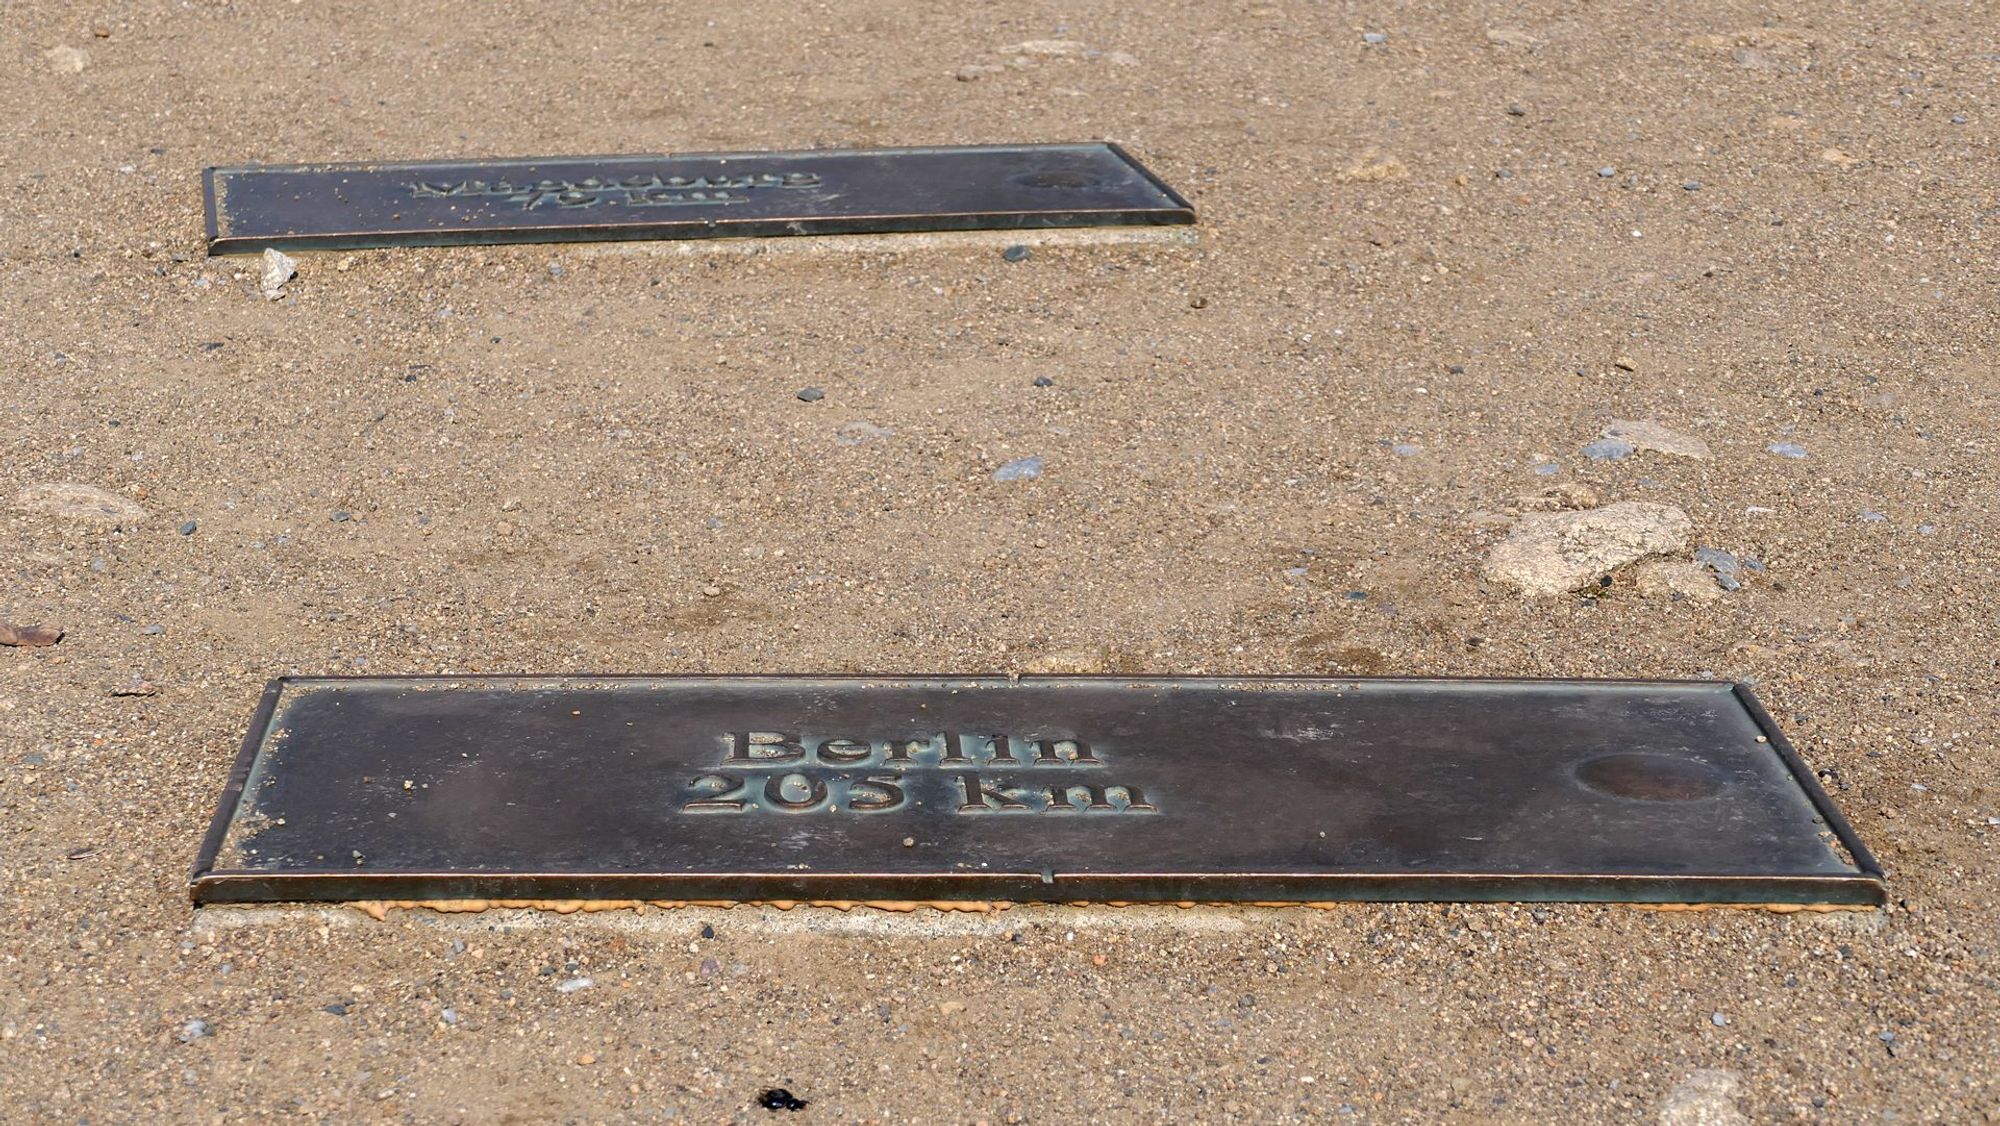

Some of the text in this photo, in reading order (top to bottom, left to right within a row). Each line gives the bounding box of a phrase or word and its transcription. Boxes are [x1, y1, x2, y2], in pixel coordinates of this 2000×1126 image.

[719, 729, 1107, 767] Berlin
[681, 772, 1160, 813] 205 km
